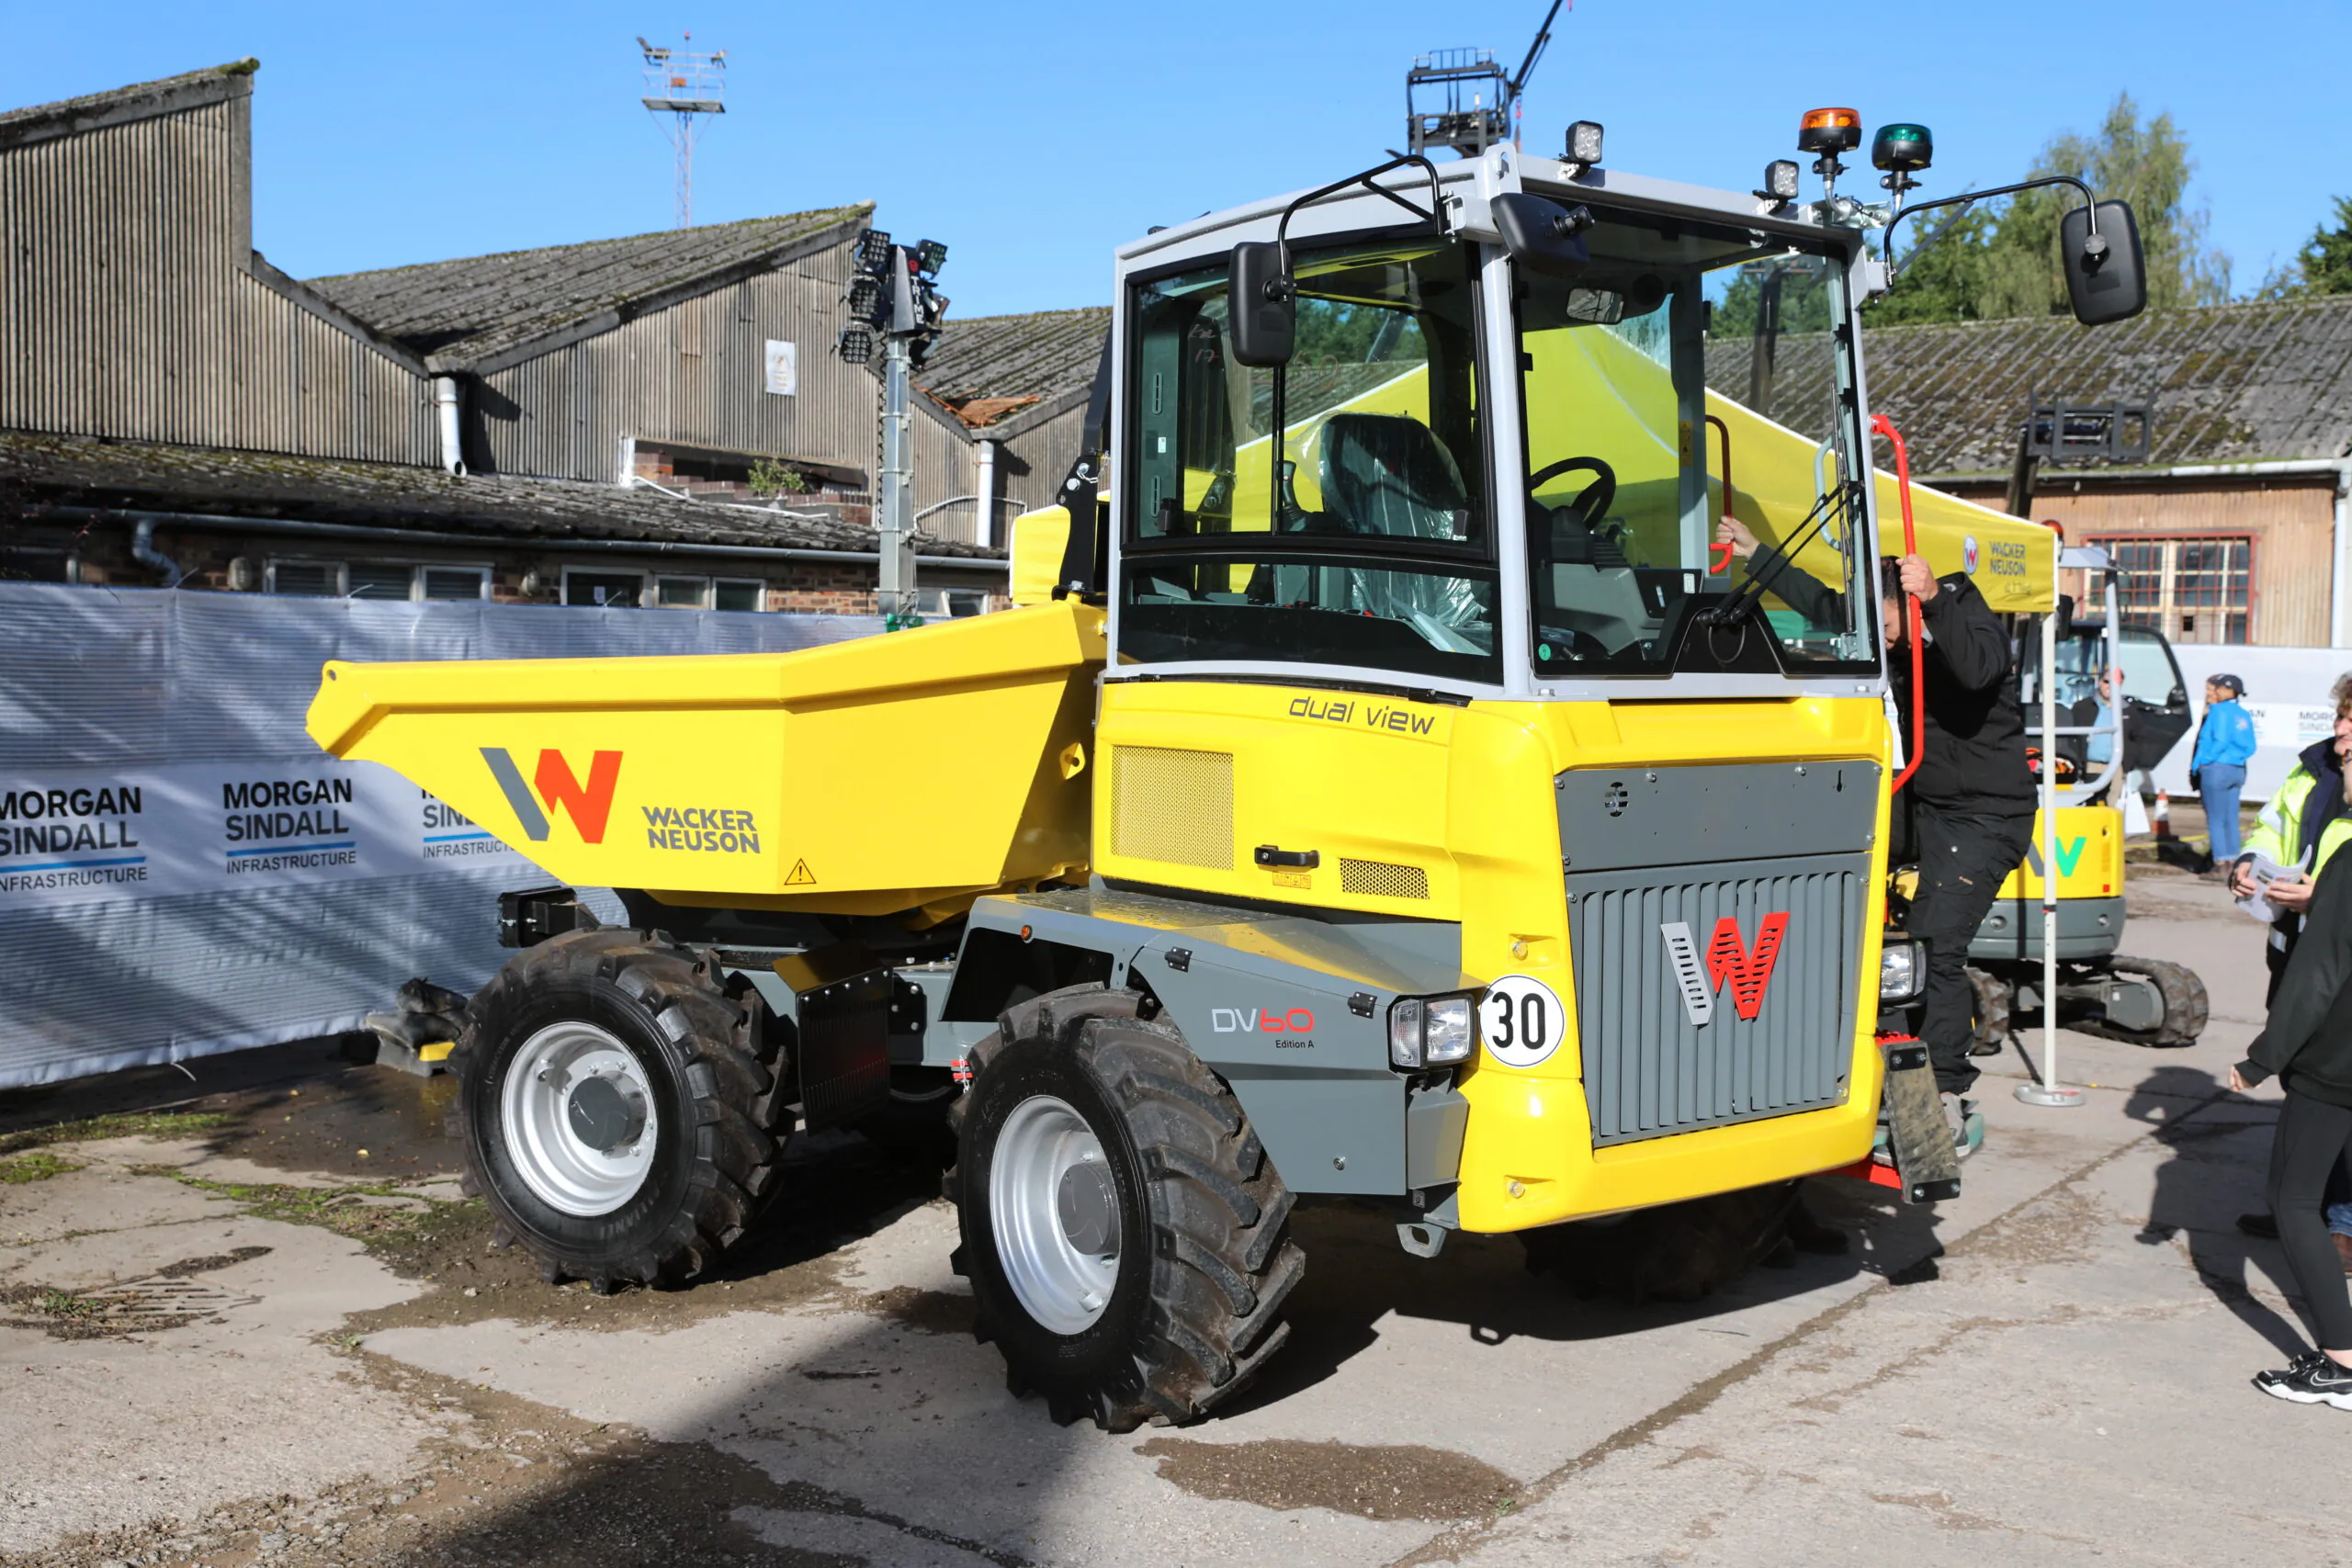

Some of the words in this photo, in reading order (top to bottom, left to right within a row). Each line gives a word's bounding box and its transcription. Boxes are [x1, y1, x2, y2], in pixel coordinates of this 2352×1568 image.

[910, 276, 924, 324] TRIME
[1989, 541, 2026, 558] WACKER
[1990, 558, 2026, 576] NEUSON
[1289, 696, 1355, 723] dual
[1367, 705, 1435, 735] view
[0, 786, 141, 820] MORGAN
[223, 779, 352, 809] MORGAN
[226, 809, 349, 841] SINDALL
[641, 806, 757, 831] WACKER
[0, 821, 138, 856] SINDALL
[648, 829, 761, 853] NEUSON
[227, 851, 356, 874] INFRASTRUCTURE
[1211, 1009, 1315, 1032] DV60
[1491, 991, 1546, 1050] 30
[1275, 1039, 1306, 1048] Edition
[1307, 1039, 1315, 1048] A
